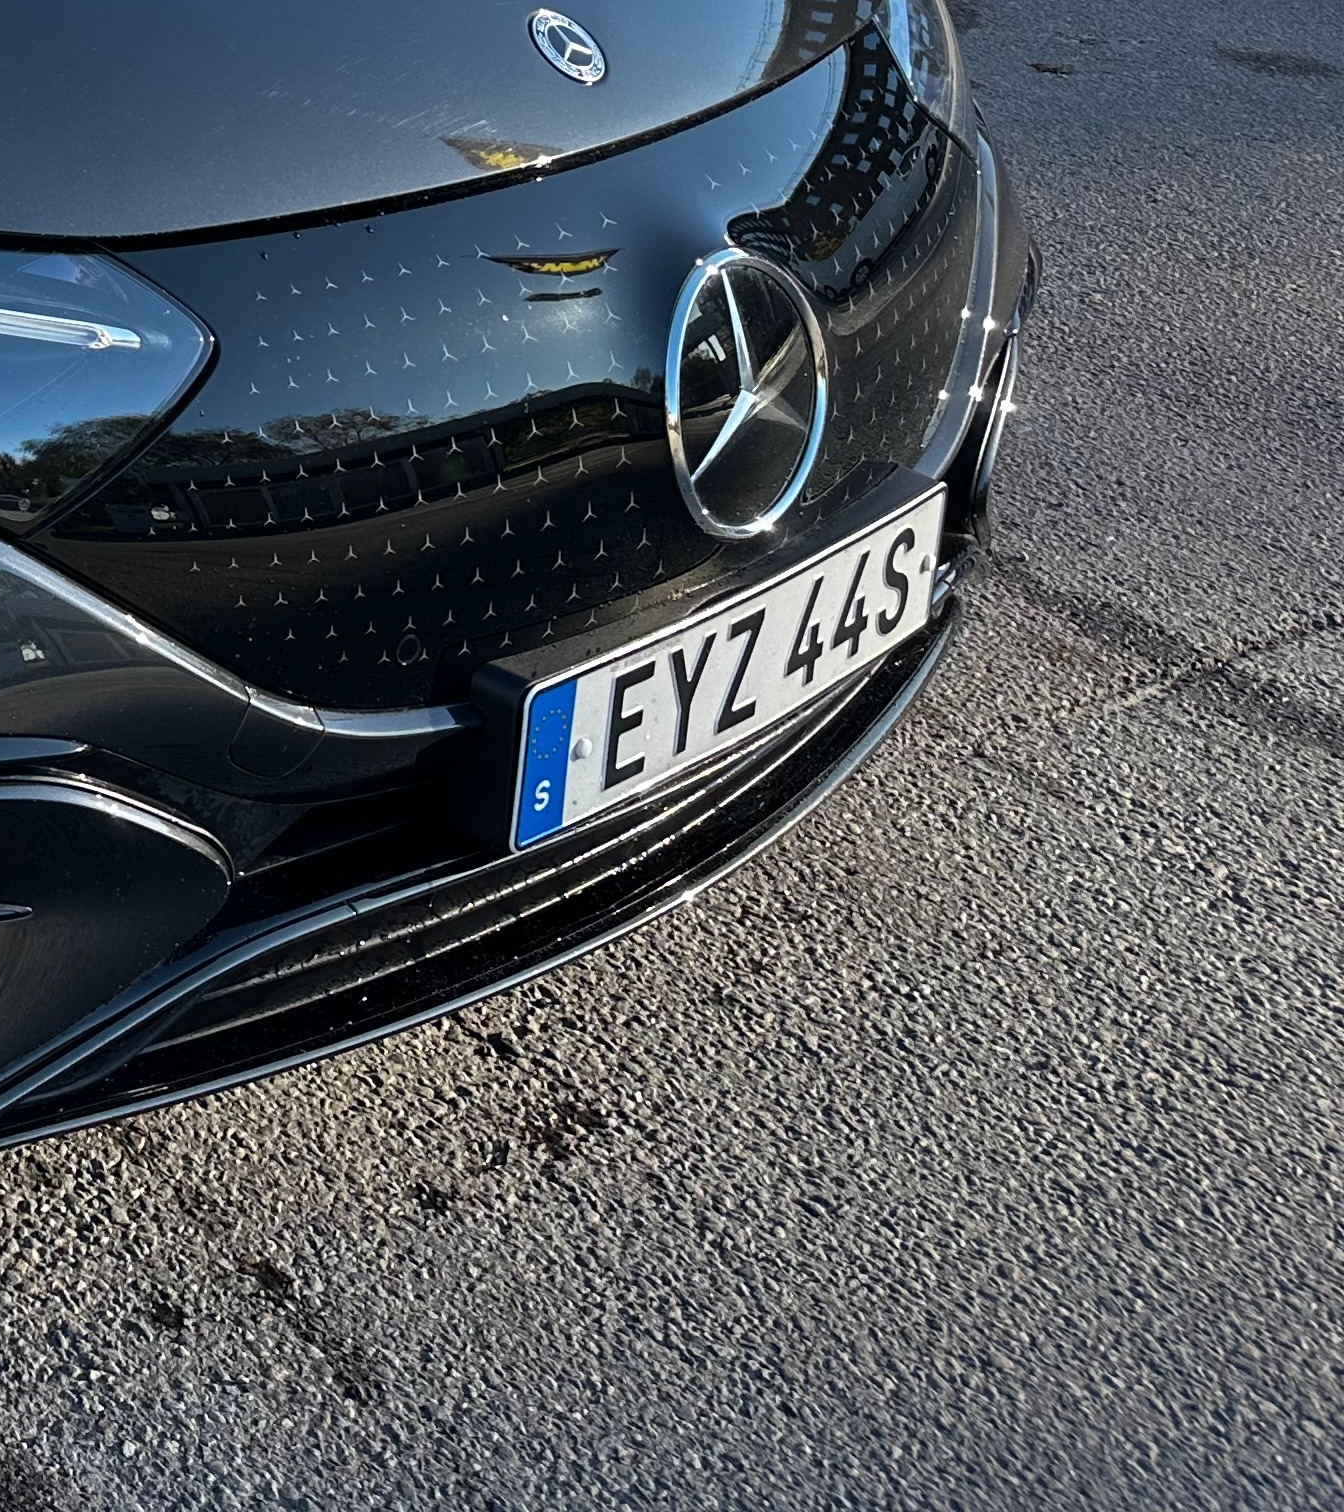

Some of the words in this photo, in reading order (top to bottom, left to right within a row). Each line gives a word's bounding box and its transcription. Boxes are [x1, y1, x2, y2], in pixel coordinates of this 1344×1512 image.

[603, 606, 767, 790] EYZ
[783, 526, 916, 687] 44S
[534, 778, 551, 813] S
